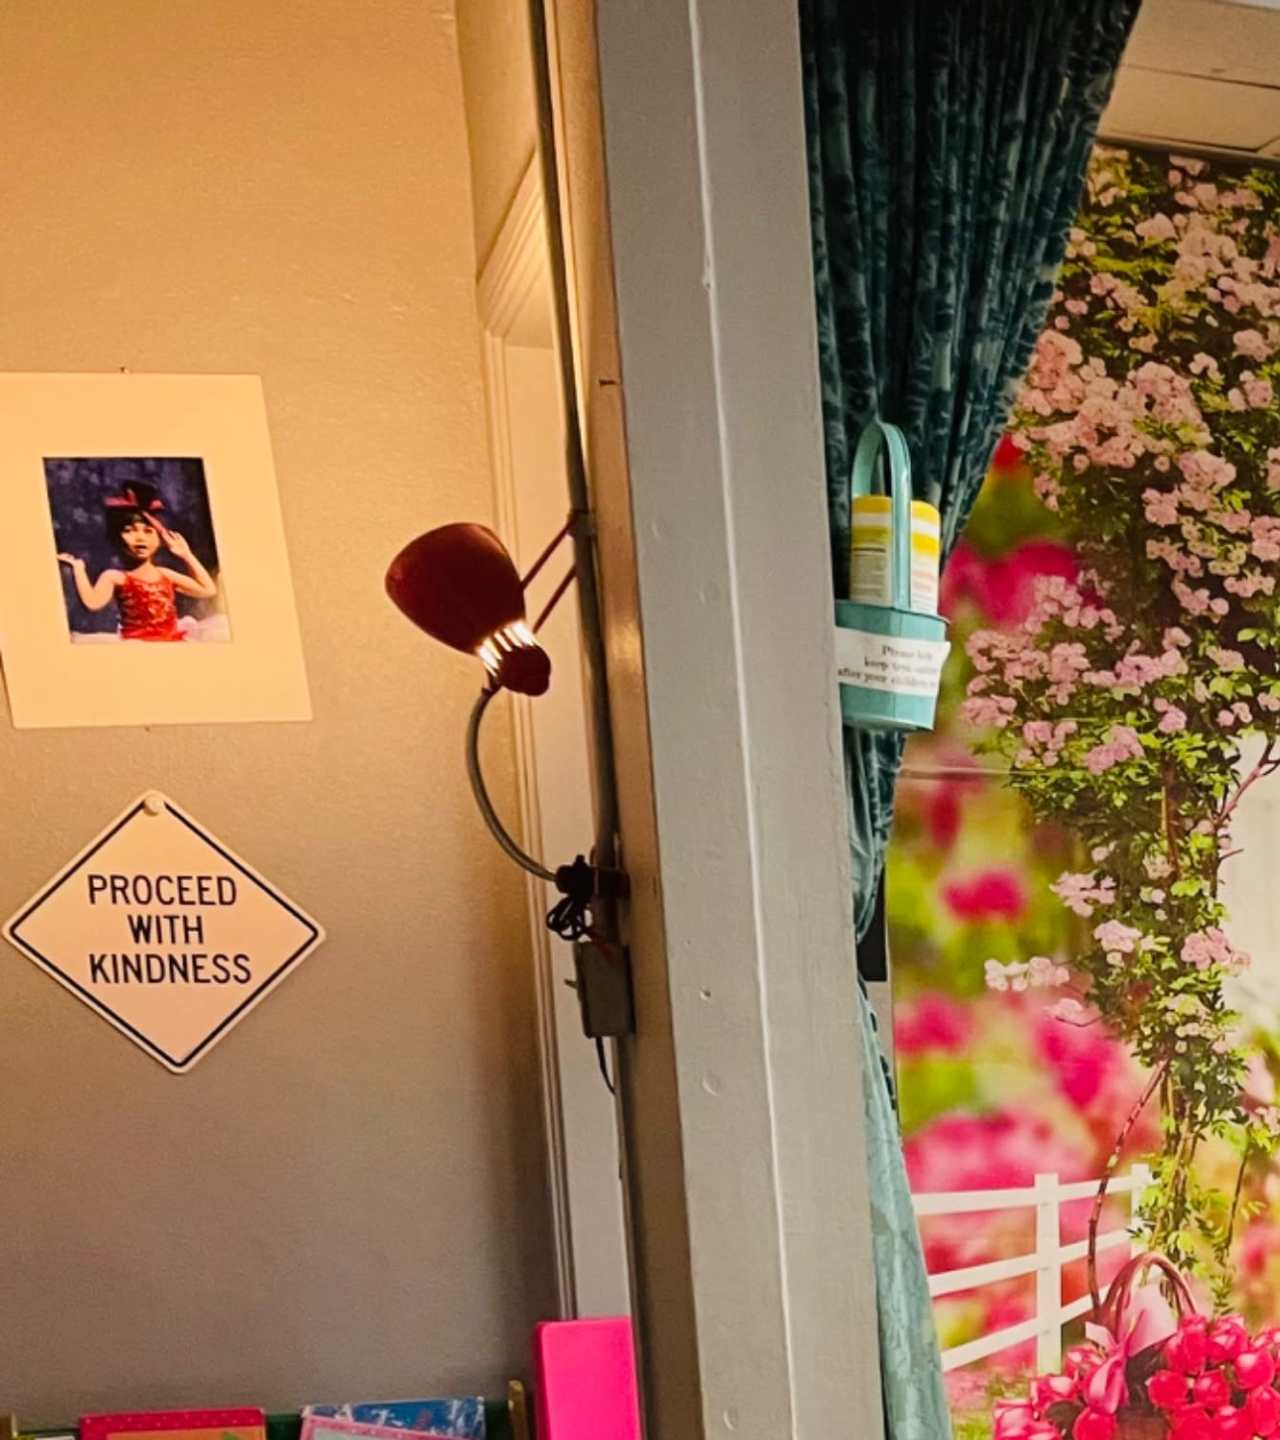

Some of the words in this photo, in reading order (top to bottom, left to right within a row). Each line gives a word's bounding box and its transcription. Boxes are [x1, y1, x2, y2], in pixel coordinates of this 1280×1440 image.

[87, 874, 238, 906] PROCEED
[127, 914, 204, 945] WITH
[88, 953, 252, 984] KINDNESS
